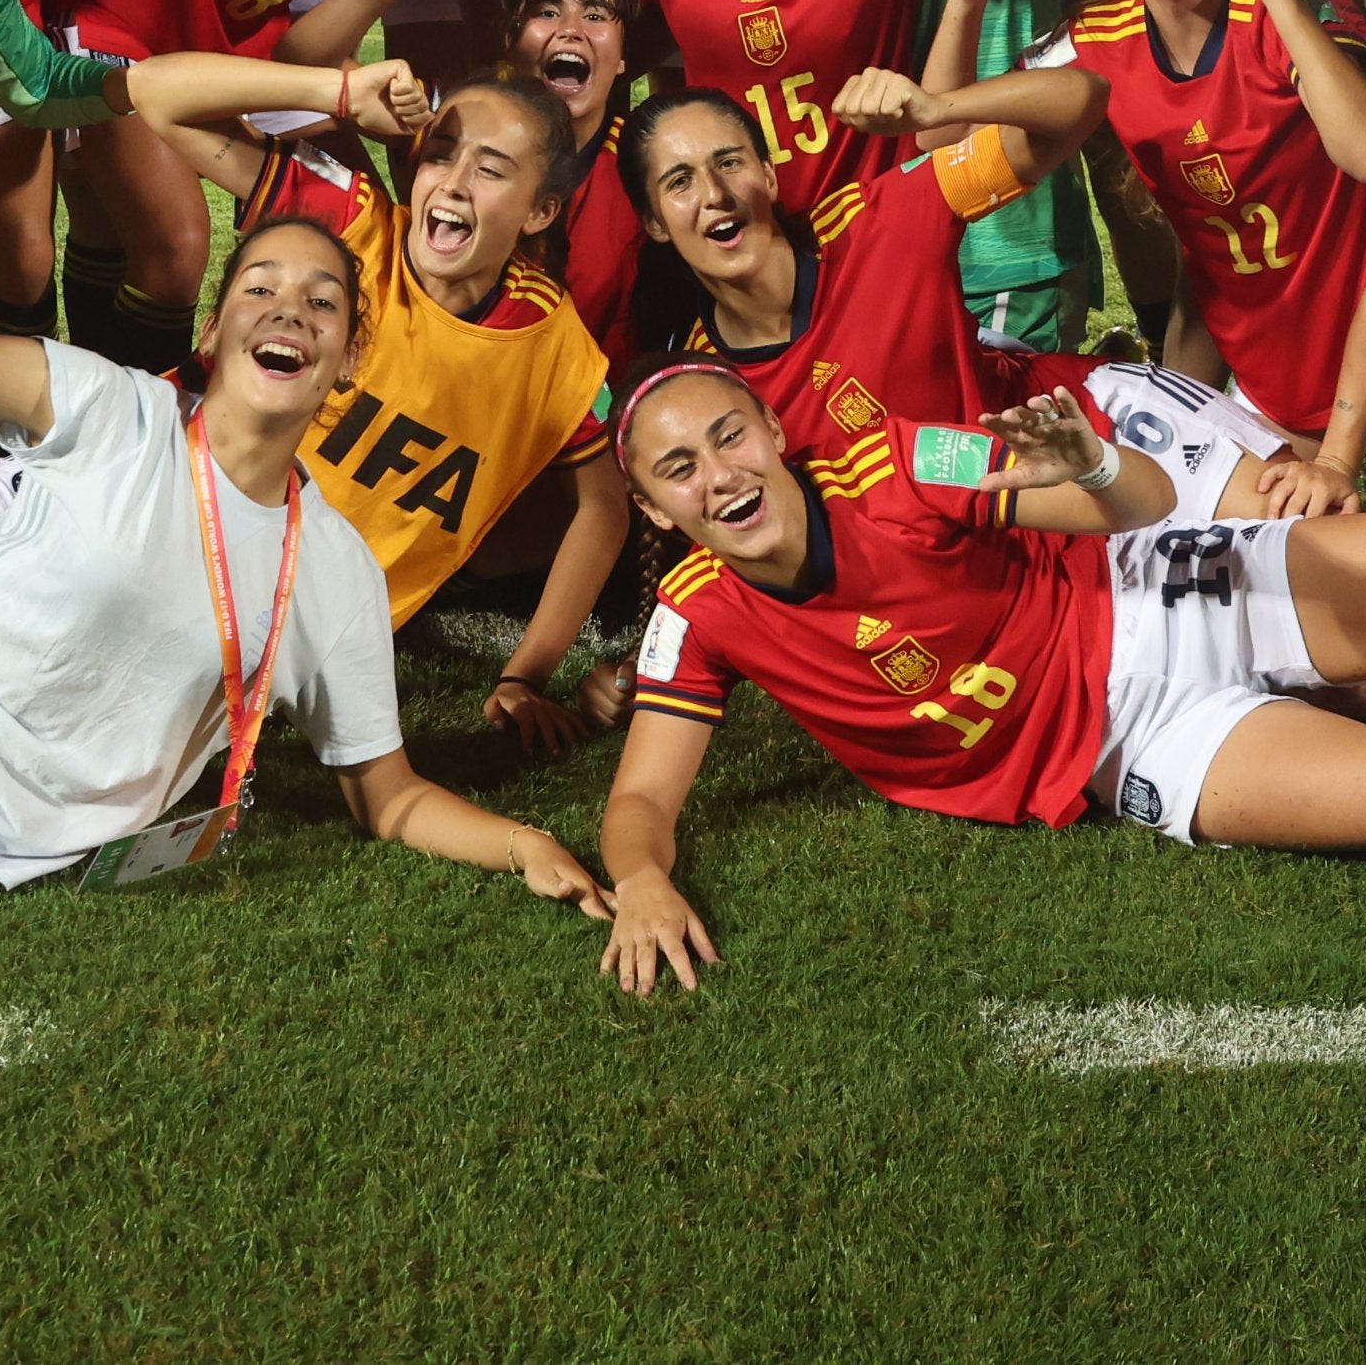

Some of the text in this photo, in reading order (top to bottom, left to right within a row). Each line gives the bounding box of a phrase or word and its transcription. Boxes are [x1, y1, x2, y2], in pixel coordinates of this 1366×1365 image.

[745, 71, 829, 165] 15
[1184, 134, 1210, 145] adidas
[1204, 202, 1298, 274] 12
[814, 361, 842, 391] adidas
[316, 382, 480, 534] IFA
[934, 429, 946, 478] LIVING
[942, 431, 956, 478] FOOTBALL
[1189, 442, 1211, 475] adidas
[200, 475, 212, 500] INDIA
[203, 500, 215, 521] CUP
[207, 521, 221, 555] WORLD
[212, 555, 228, 599] WOMEN'S
[284, 551, 294, 576] INDIA
[1156, 523, 1235, 609] 18
[280, 575, 290, 595] CUP
[221, 599, 230, 621] U-17
[275, 595, 285, 628] WORLD
[225, 622, 234, 640] FIFA
[856, 619, 892, 650] adidas
[265, 626, 279, 670] WOMEN'S
[259, 669, 269, 691] U-17
[254, 692, 265, 713] FIFA
[910, 661, 1017, 750] 18
